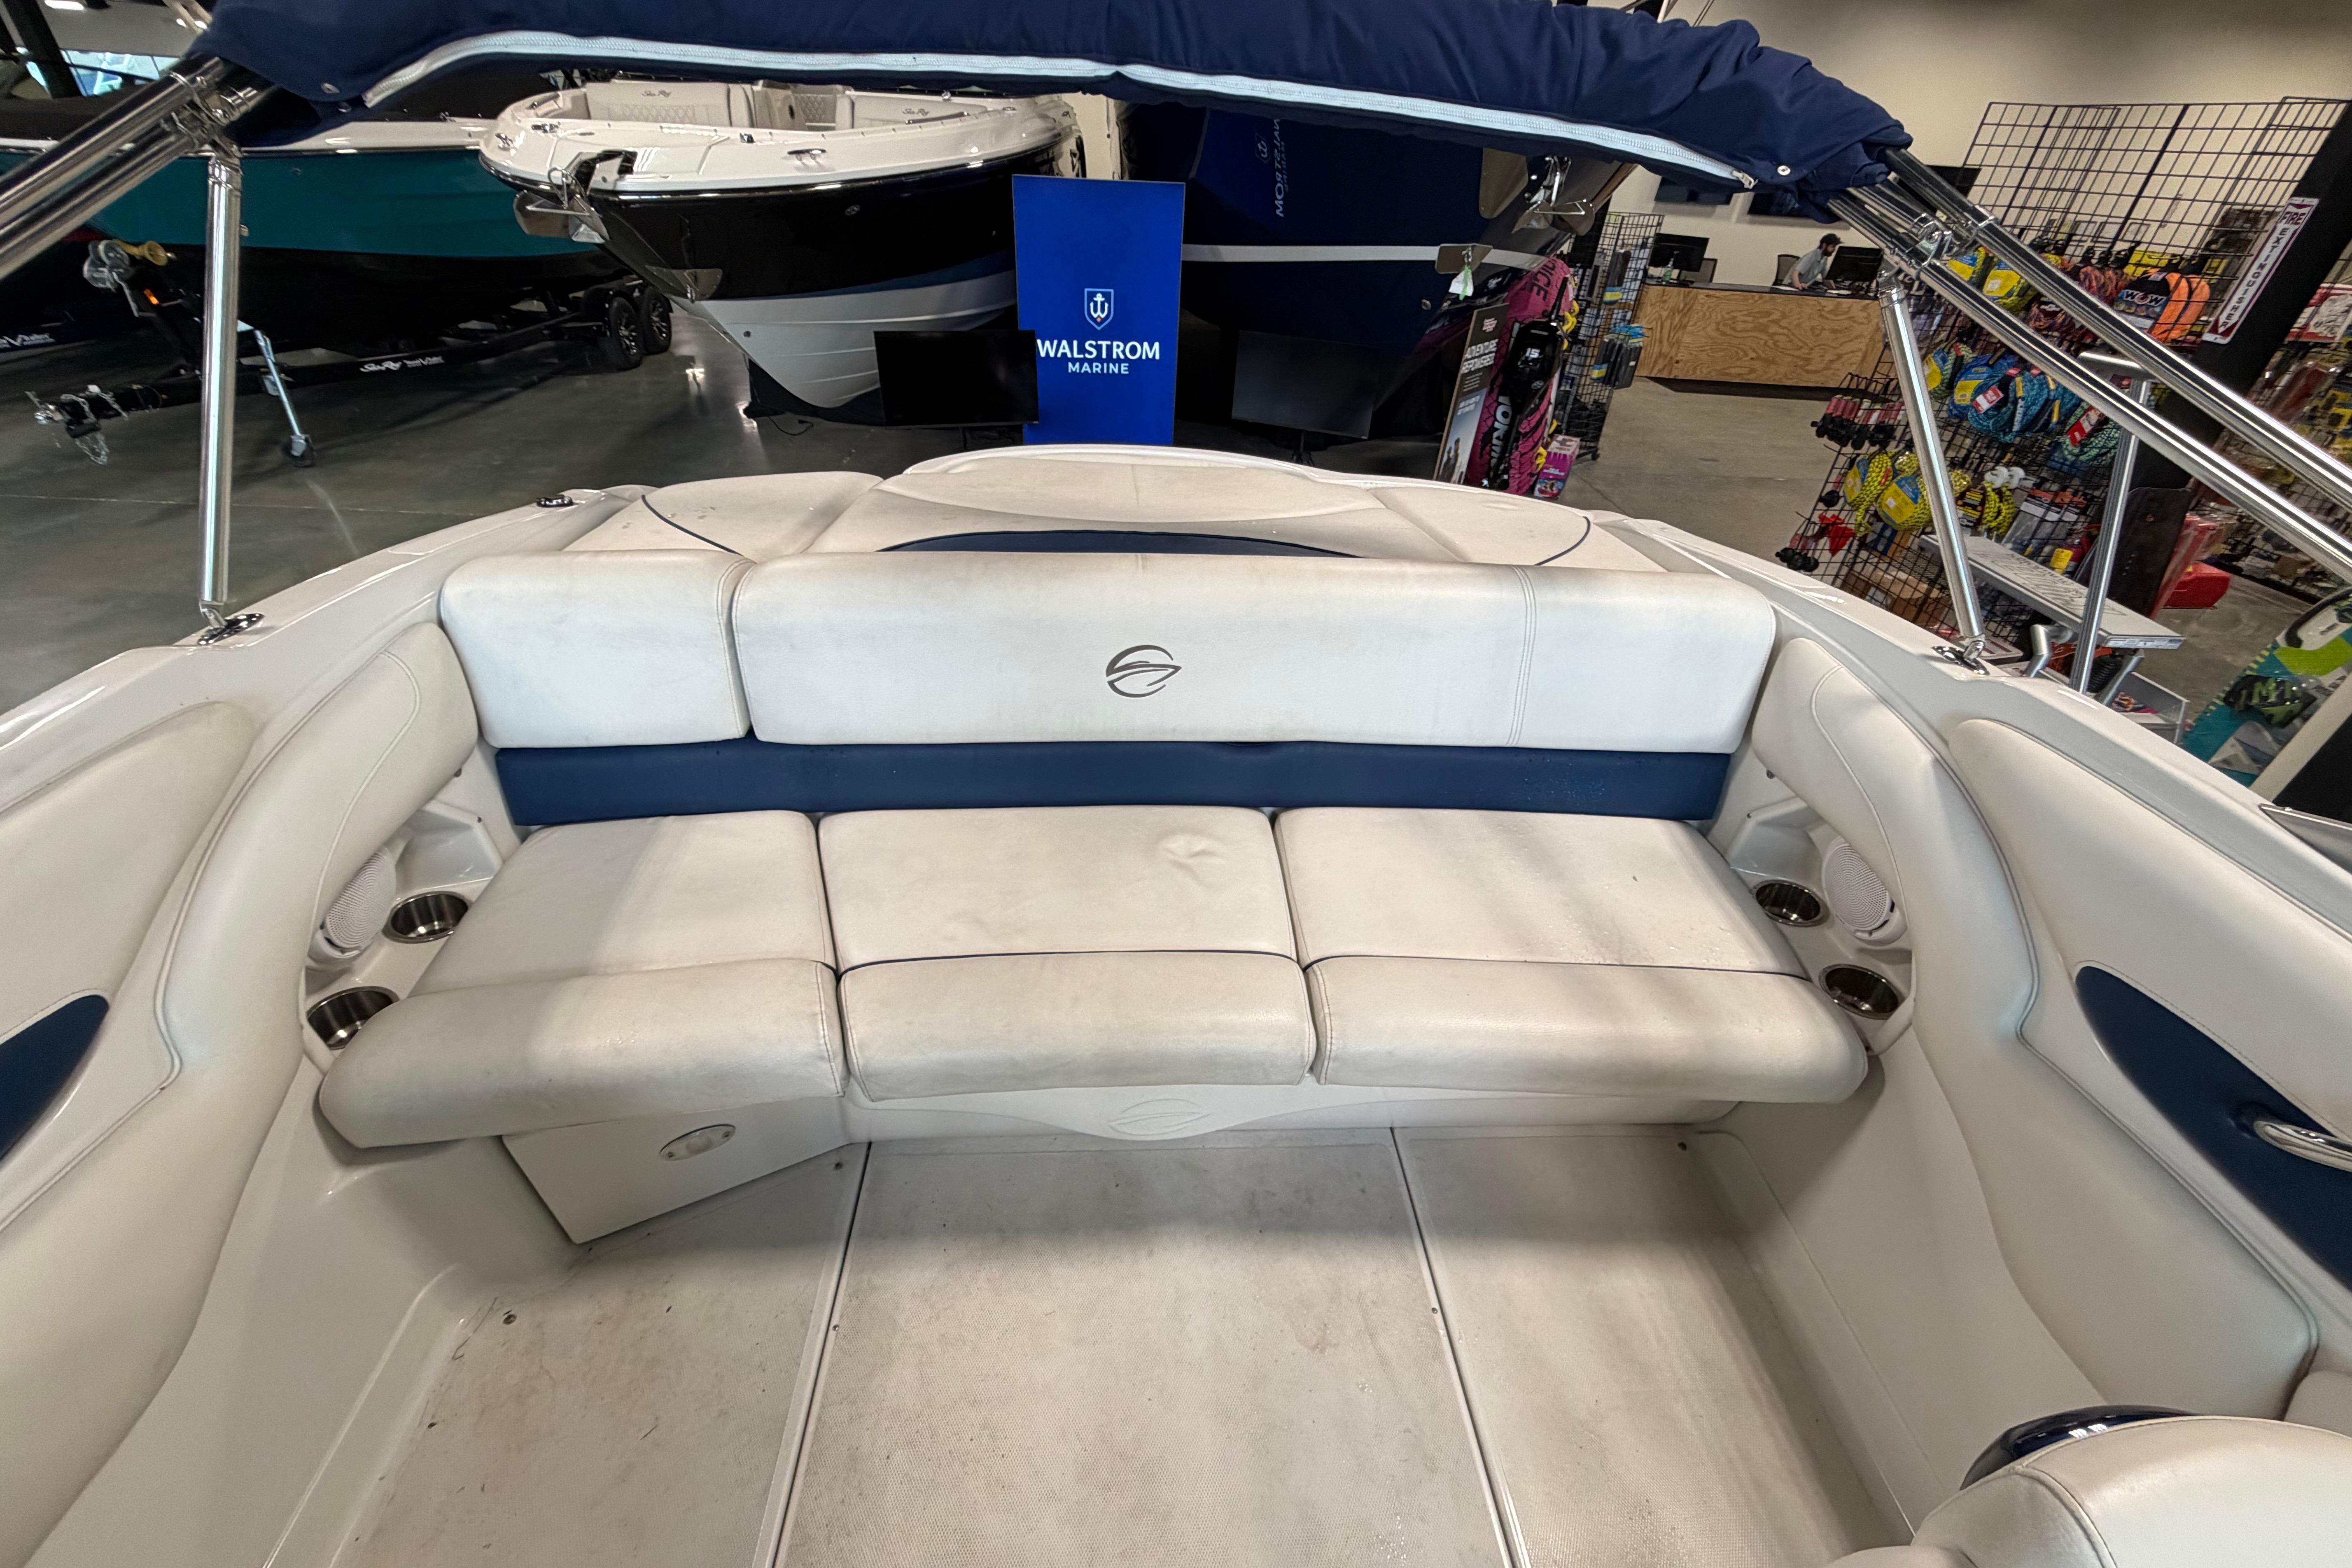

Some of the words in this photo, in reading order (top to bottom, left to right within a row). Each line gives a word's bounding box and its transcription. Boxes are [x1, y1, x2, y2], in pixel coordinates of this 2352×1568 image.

[2286, 211, 2307, 226] FIRE
[2219, 228, 2290, 328] EXTINGUISHER
[2123, 289, 2167, 307] WOW
[1036, 339, 1160, 360] WALSTROM
[1526, 348, 1540, 358] 15
[1068, 362, 1129, 374] MARINE
